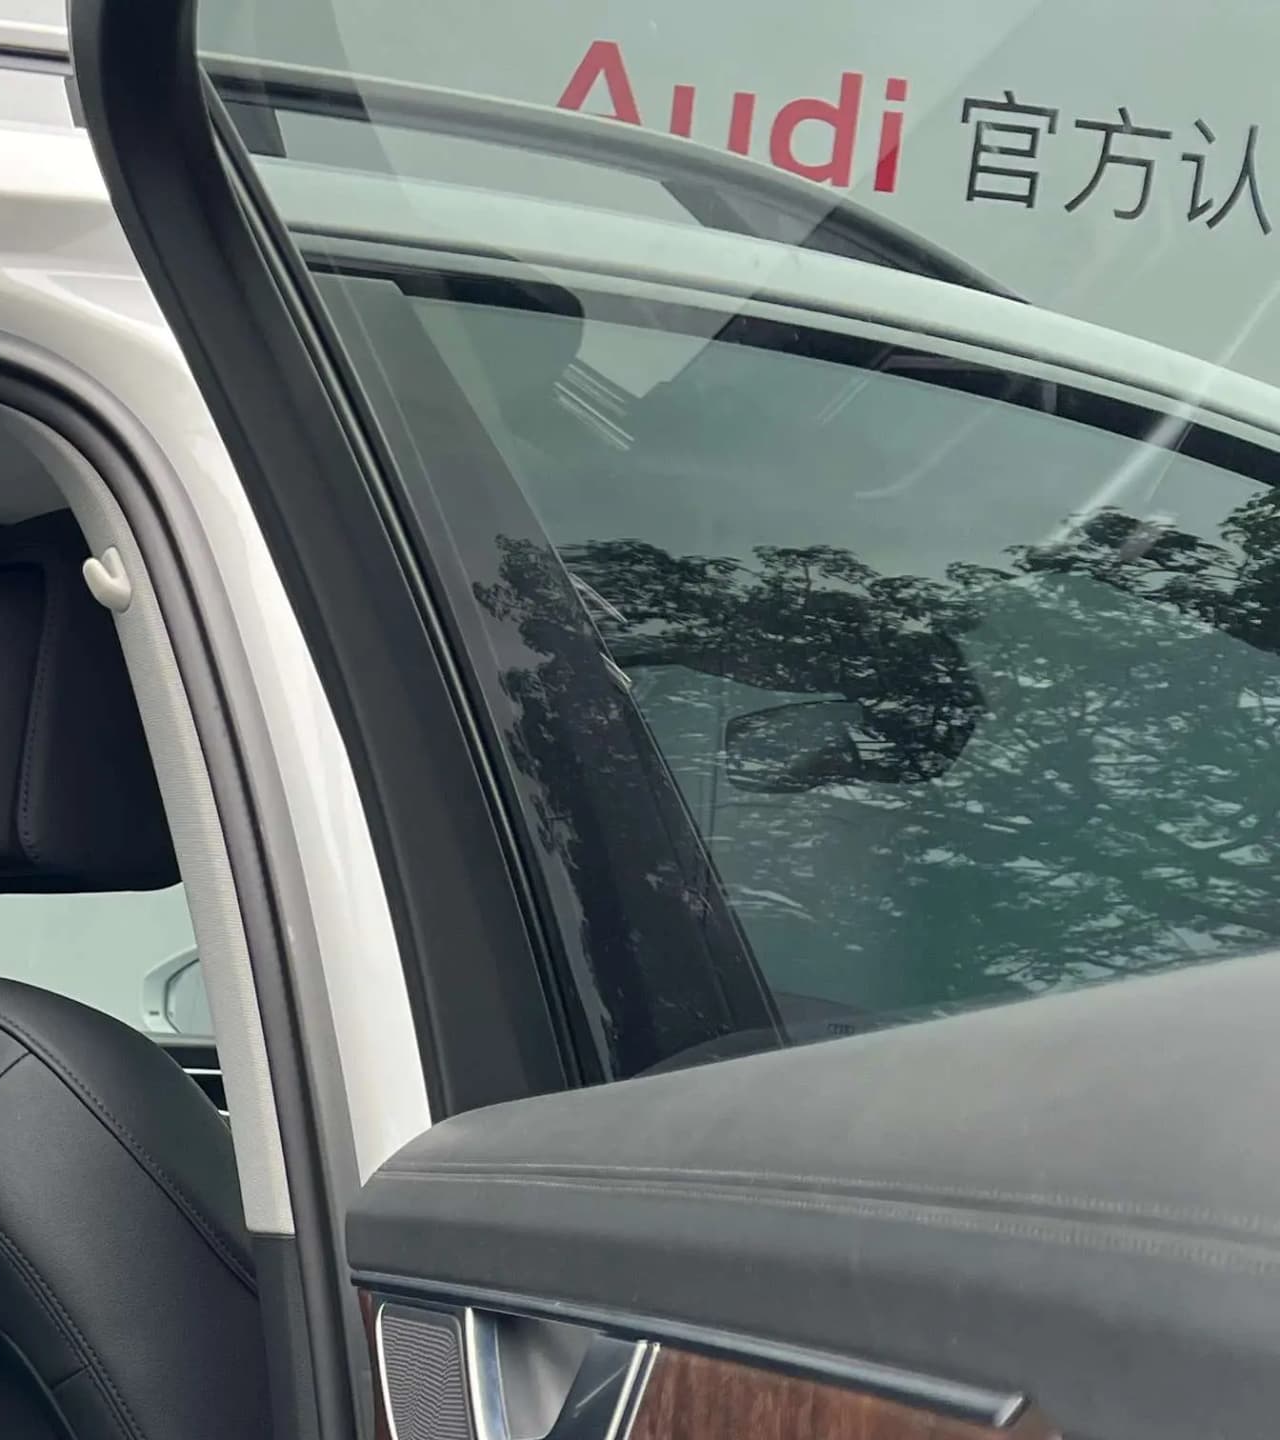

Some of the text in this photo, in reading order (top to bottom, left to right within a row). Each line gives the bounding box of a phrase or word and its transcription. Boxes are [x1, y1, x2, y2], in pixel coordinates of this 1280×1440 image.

[557, 40, 909, 193] Audi
[961, 90, 1272, 236] 官方认
